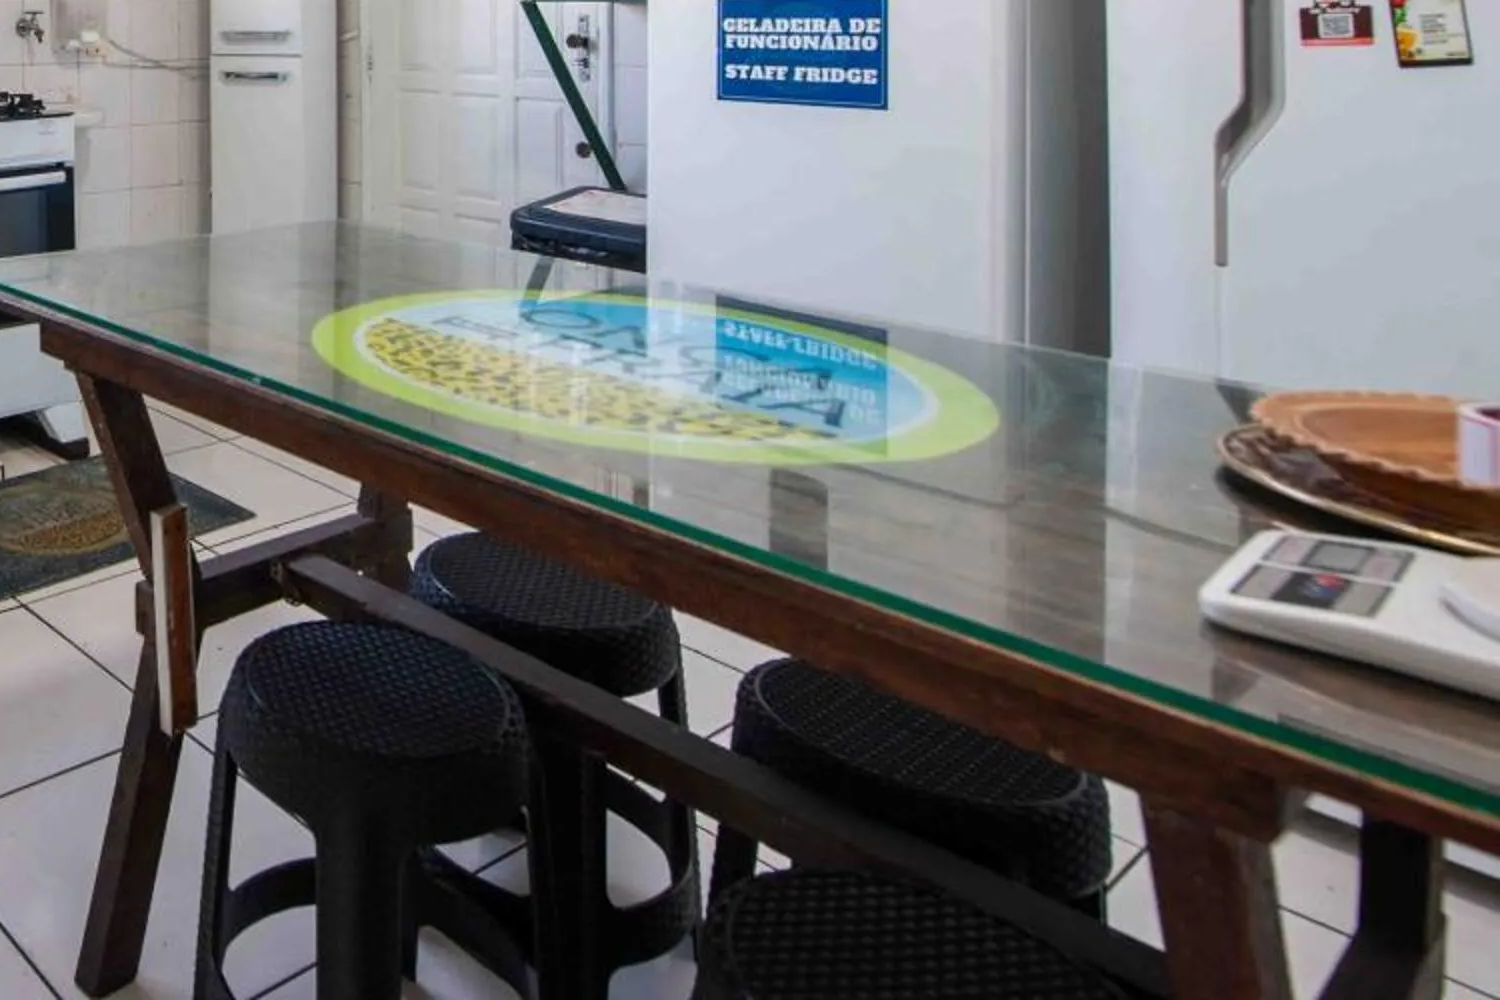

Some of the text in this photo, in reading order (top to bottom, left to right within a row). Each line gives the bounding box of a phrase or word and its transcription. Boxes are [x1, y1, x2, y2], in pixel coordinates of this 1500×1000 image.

[723, 17, 881, 34] GELADEIRA DE
[724, 64, 879, 85] STAFF FRIDGE
